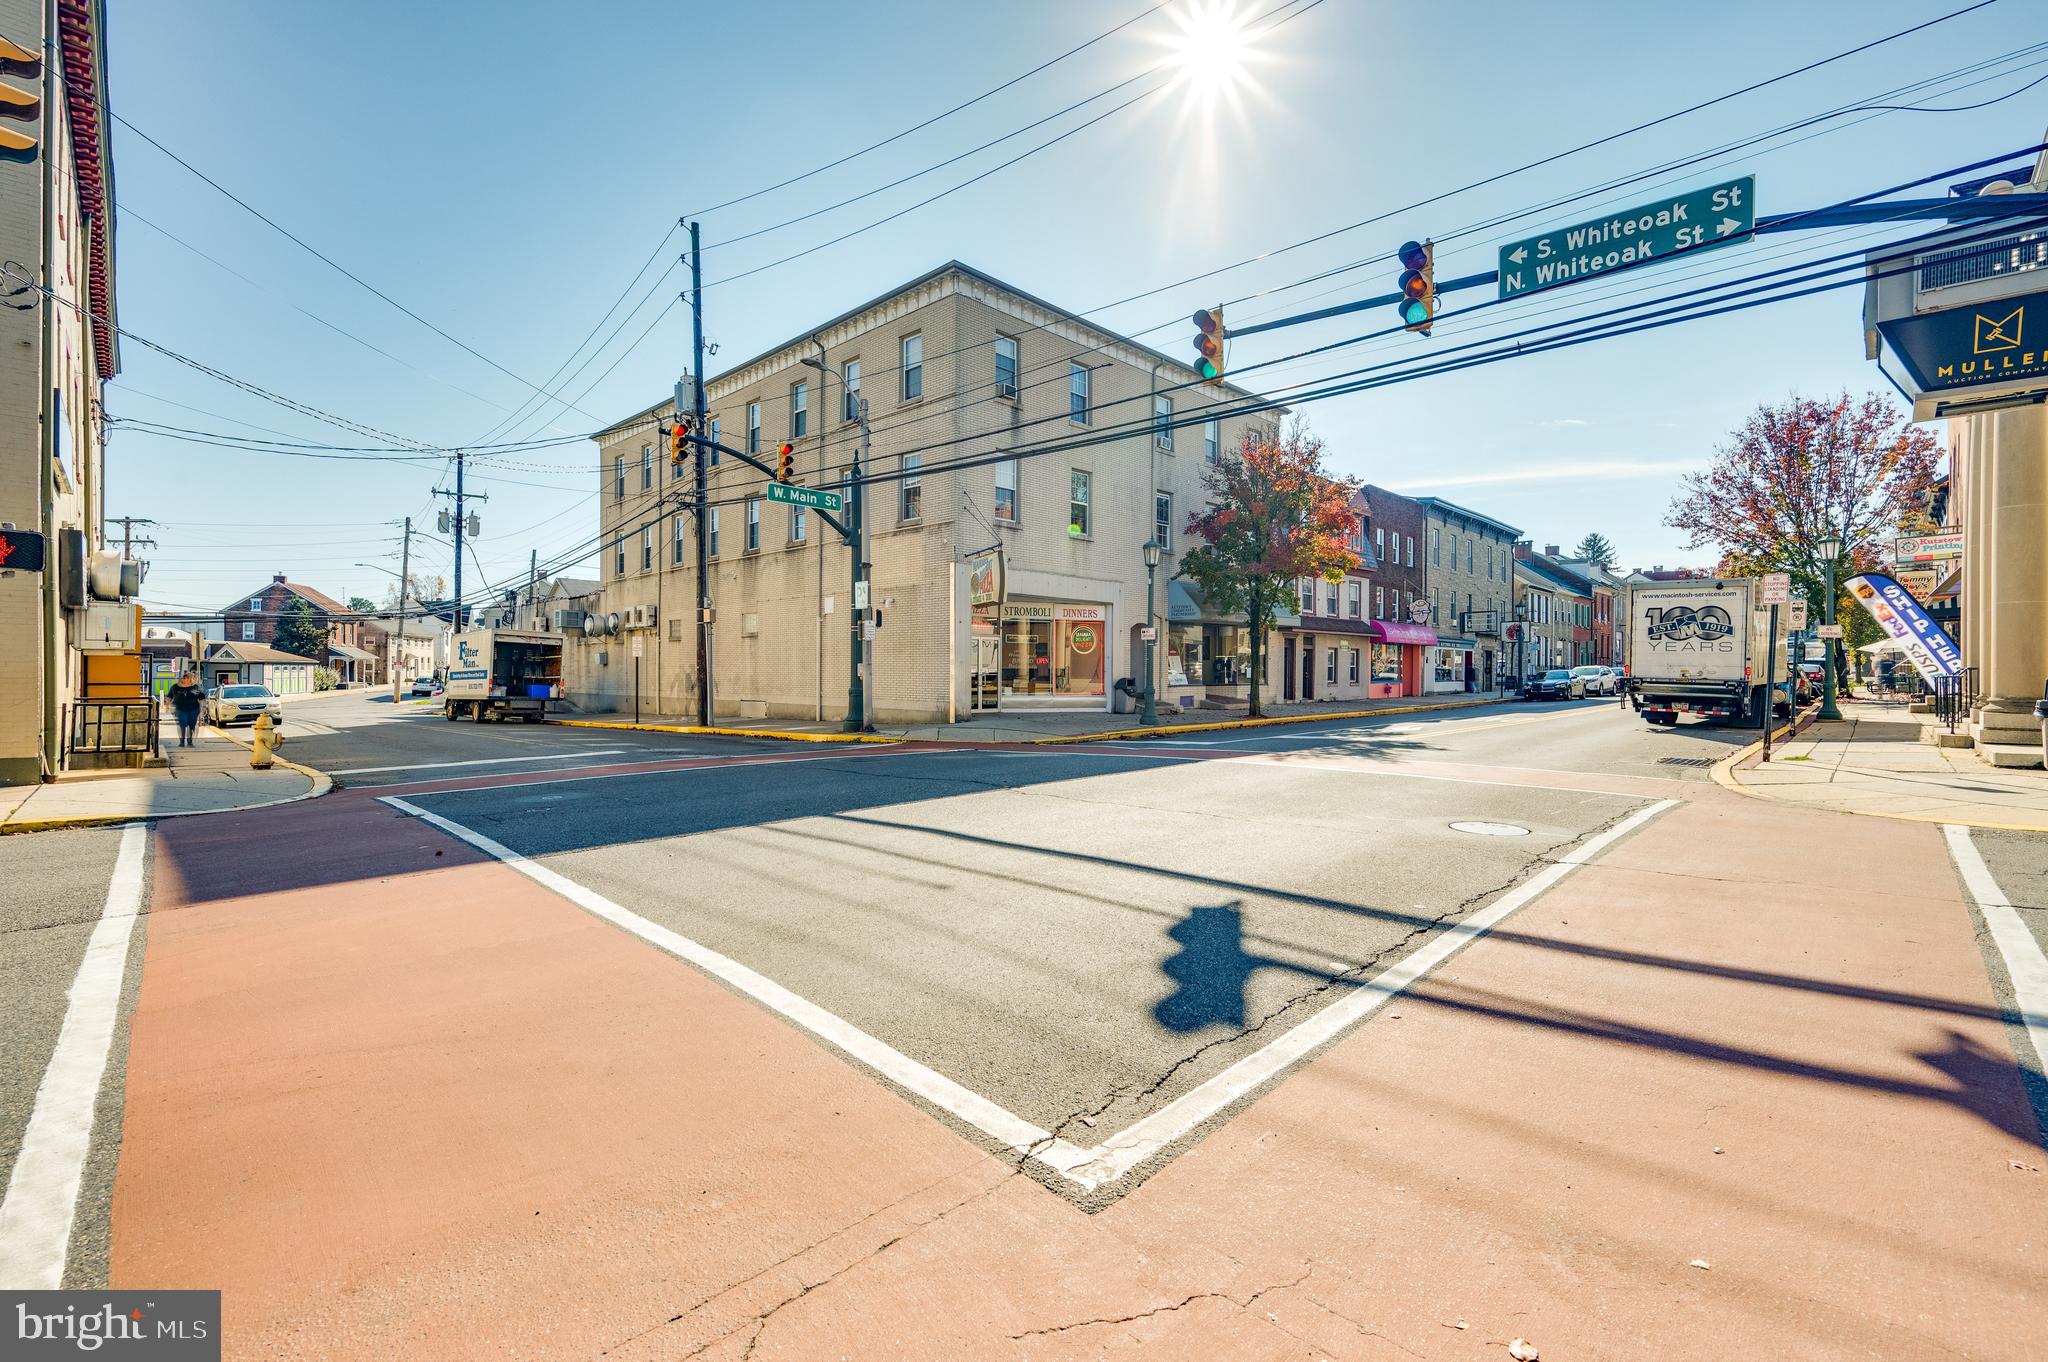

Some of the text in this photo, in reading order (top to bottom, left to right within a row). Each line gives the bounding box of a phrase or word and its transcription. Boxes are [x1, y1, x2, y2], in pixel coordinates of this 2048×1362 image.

[1536, 185, 1742, 259] S. Whiteoak St
[1506, 225, 1705, 293] N. Whiteoak St
[1947, 366, 2047, 384] AUCTION COMPANY
[773, 486, 837, 507] W. Main St
[1641, 591, 1737, 599] www.macintosh-services.com
[1003, 606, 1051, 617] STROMBOLI
[1062, 608, 1098, 619] DINNERS
[1883, 585, 1929, 634] SHIP
[1652, 622, 1729, 634] EST. 1919
[1876, 603, 1909, 638] FedEx
[458, 640, 479, 660] Filter
[1647, 641, 1733, 652] YEARS
[462, 659, 476, 668] Man
[1035, 657, 1049, 665] OPEN
[1907, 643, 1940, 676] USPS
